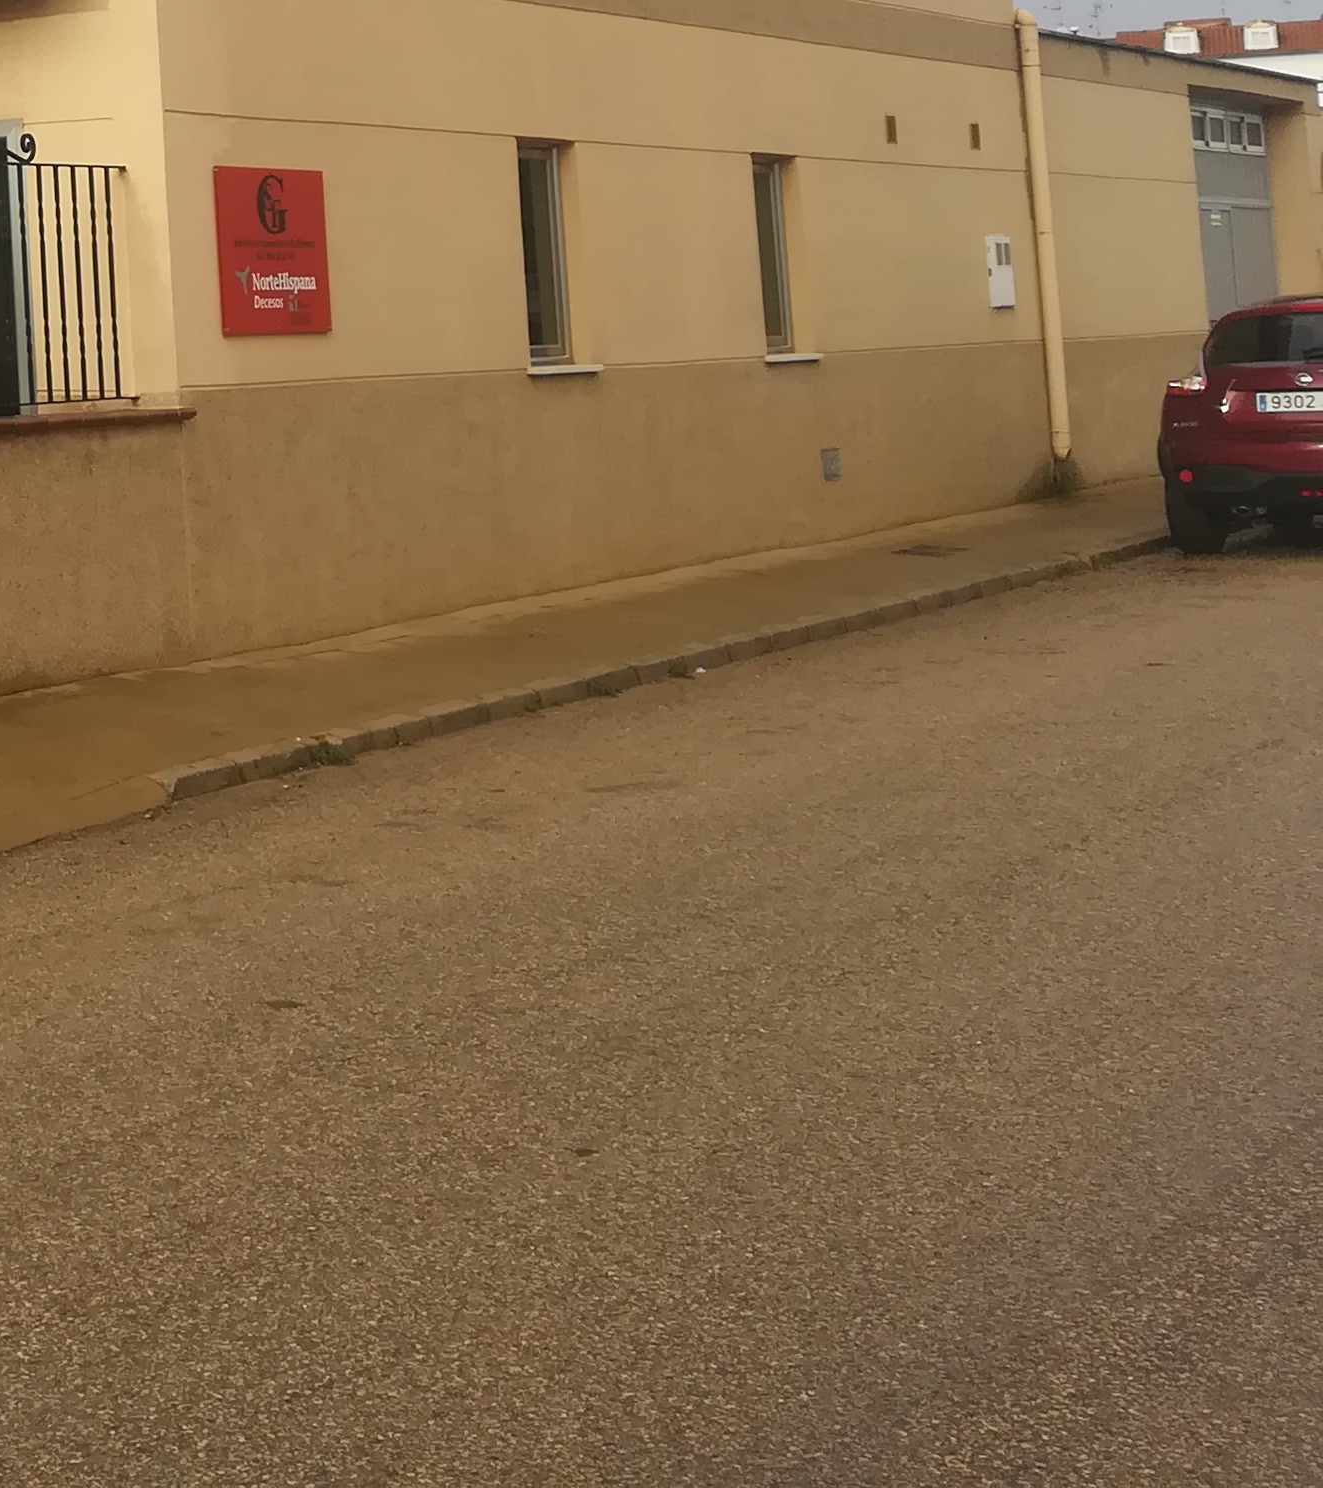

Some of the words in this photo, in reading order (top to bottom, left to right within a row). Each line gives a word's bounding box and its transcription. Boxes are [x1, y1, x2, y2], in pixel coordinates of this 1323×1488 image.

[251, 271, 317, 294] NorteHispana
[254, 295, 284, 309] Decesos
[1271, 395, 1316, 409] 9302
